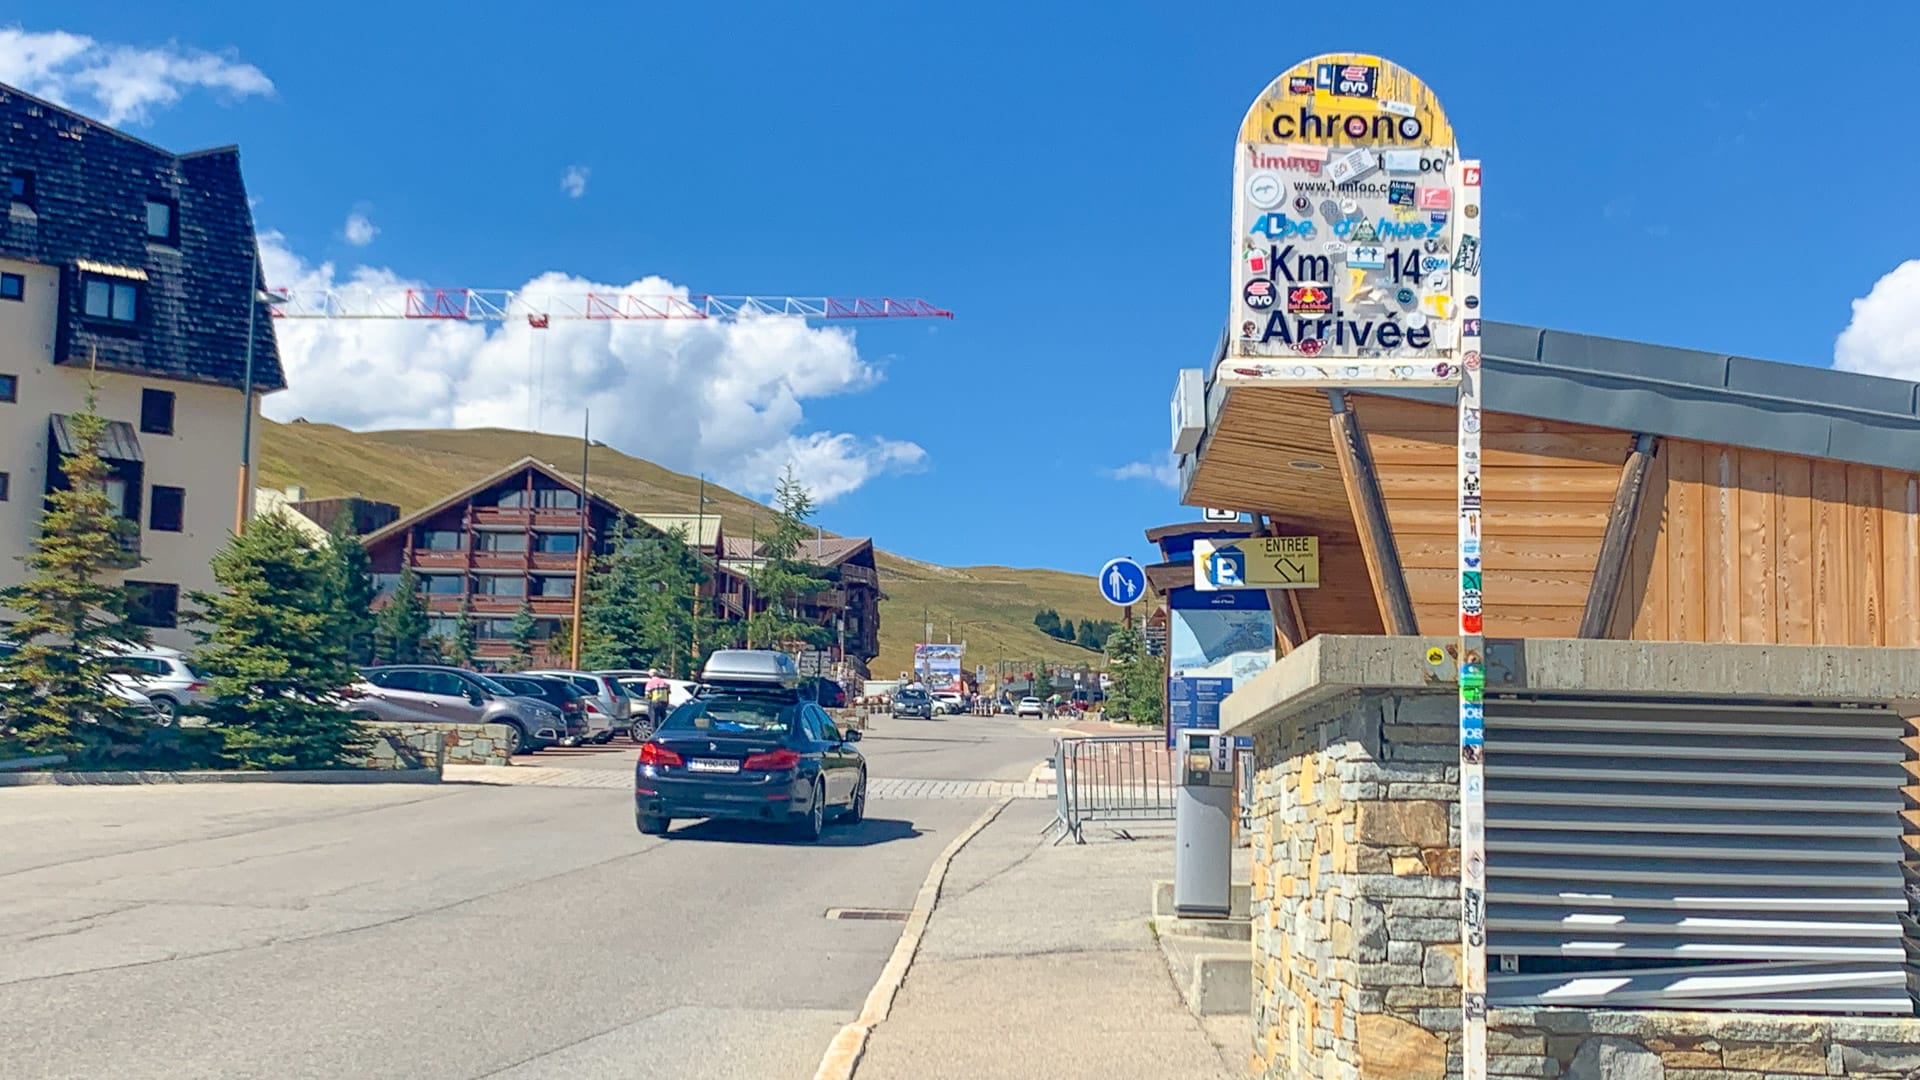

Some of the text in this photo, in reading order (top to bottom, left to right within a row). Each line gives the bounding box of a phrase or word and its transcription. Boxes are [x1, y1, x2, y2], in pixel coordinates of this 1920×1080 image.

[1272, 107, 1422, 140] chrono
[1251, 153, 1320, 173] timing
[1270, 244, 1329, 282] Km
[1387, 247, 1421, 284] 14
[1247, 295, 1273, 306] evo
[1260, 309, 1431, 349] Arrivée
